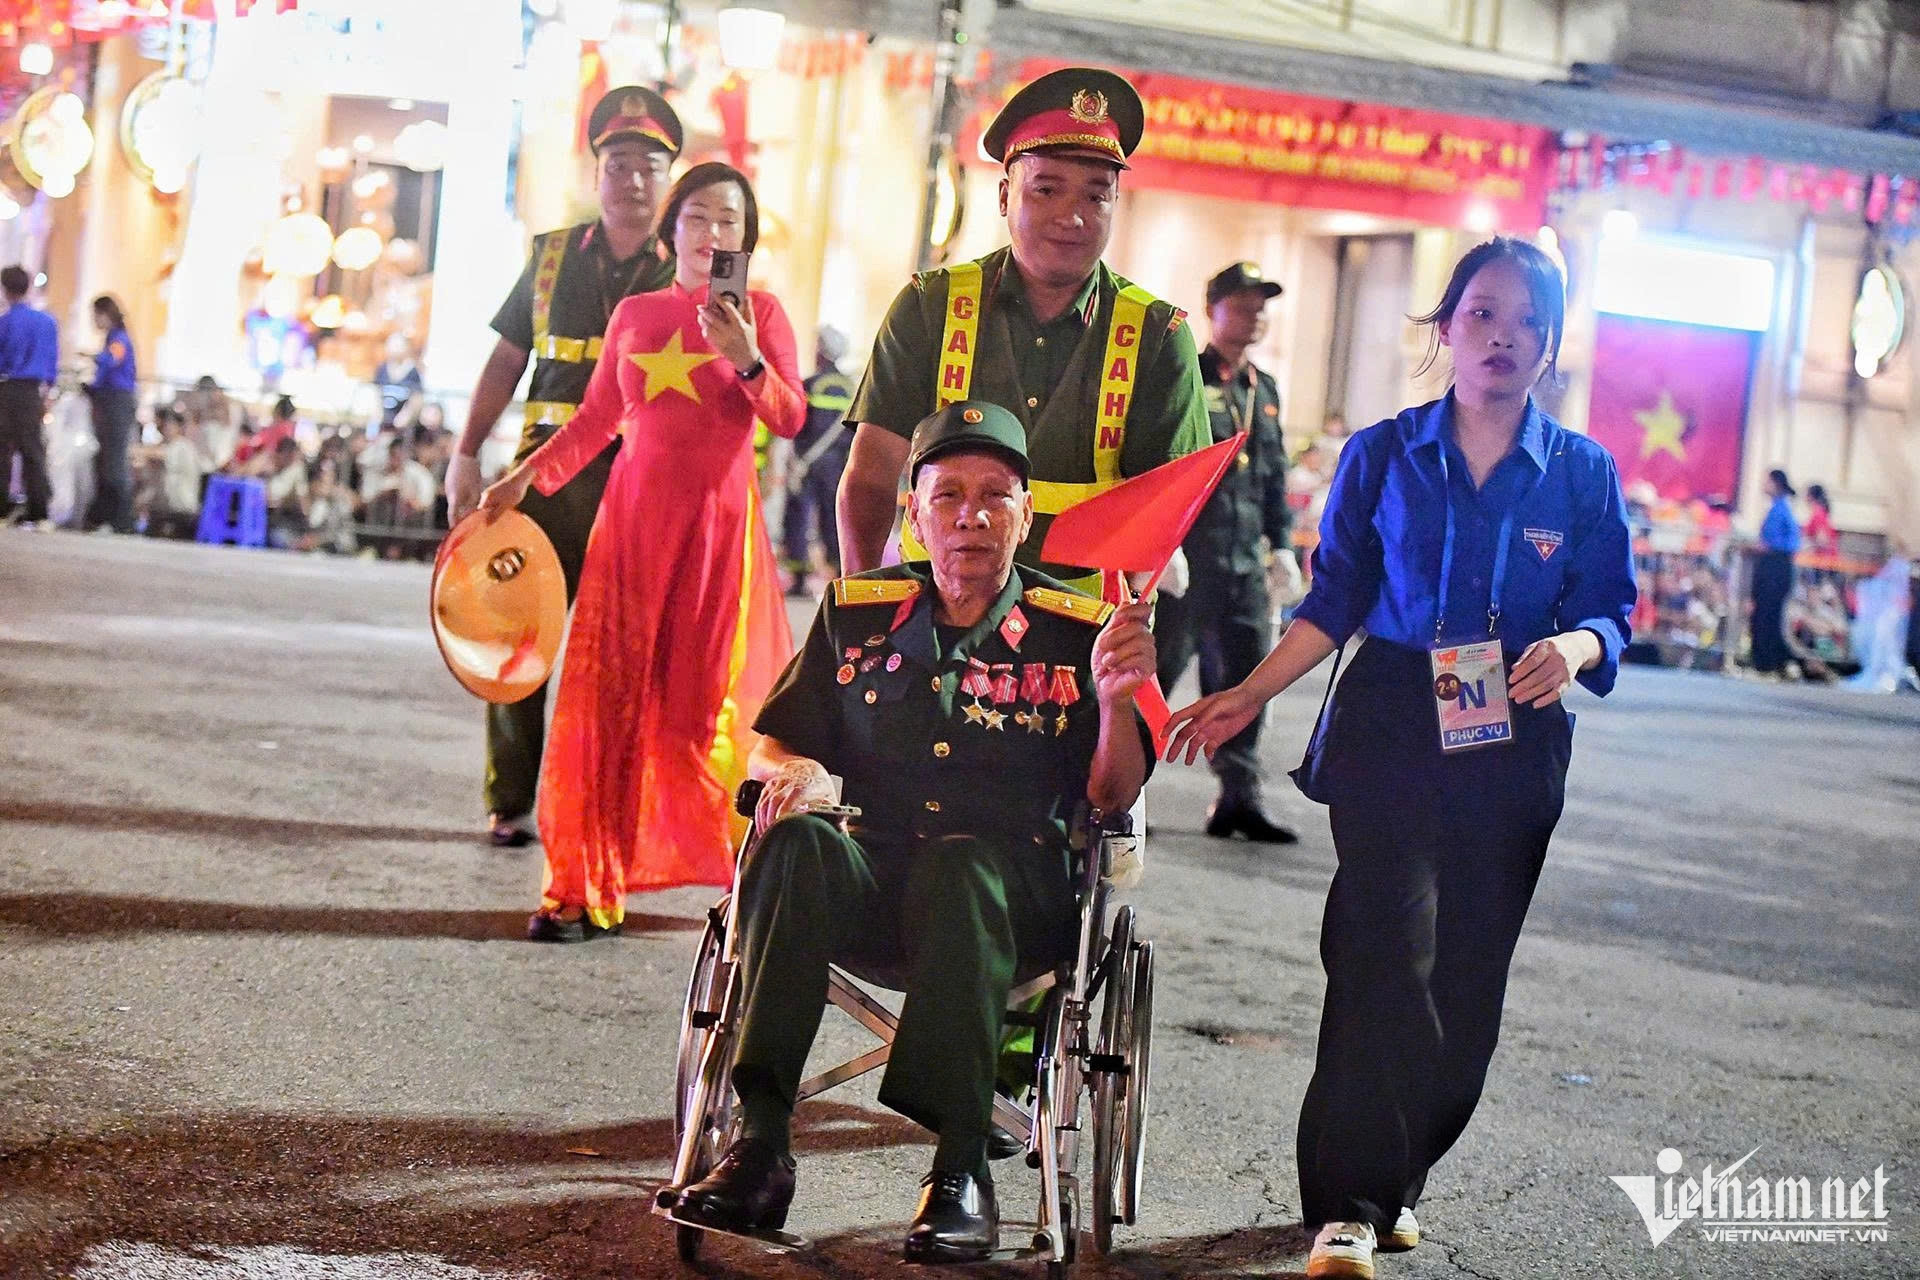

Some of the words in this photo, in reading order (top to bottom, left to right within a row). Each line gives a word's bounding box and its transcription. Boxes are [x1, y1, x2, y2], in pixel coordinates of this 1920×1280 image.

[1099, 324, 1136, 450] CAHN
[1458, 679, 1487, 711] N
[1450, 727, 1484, 742] PHỤC
[1486, 724, 1503, 737] VỤ
